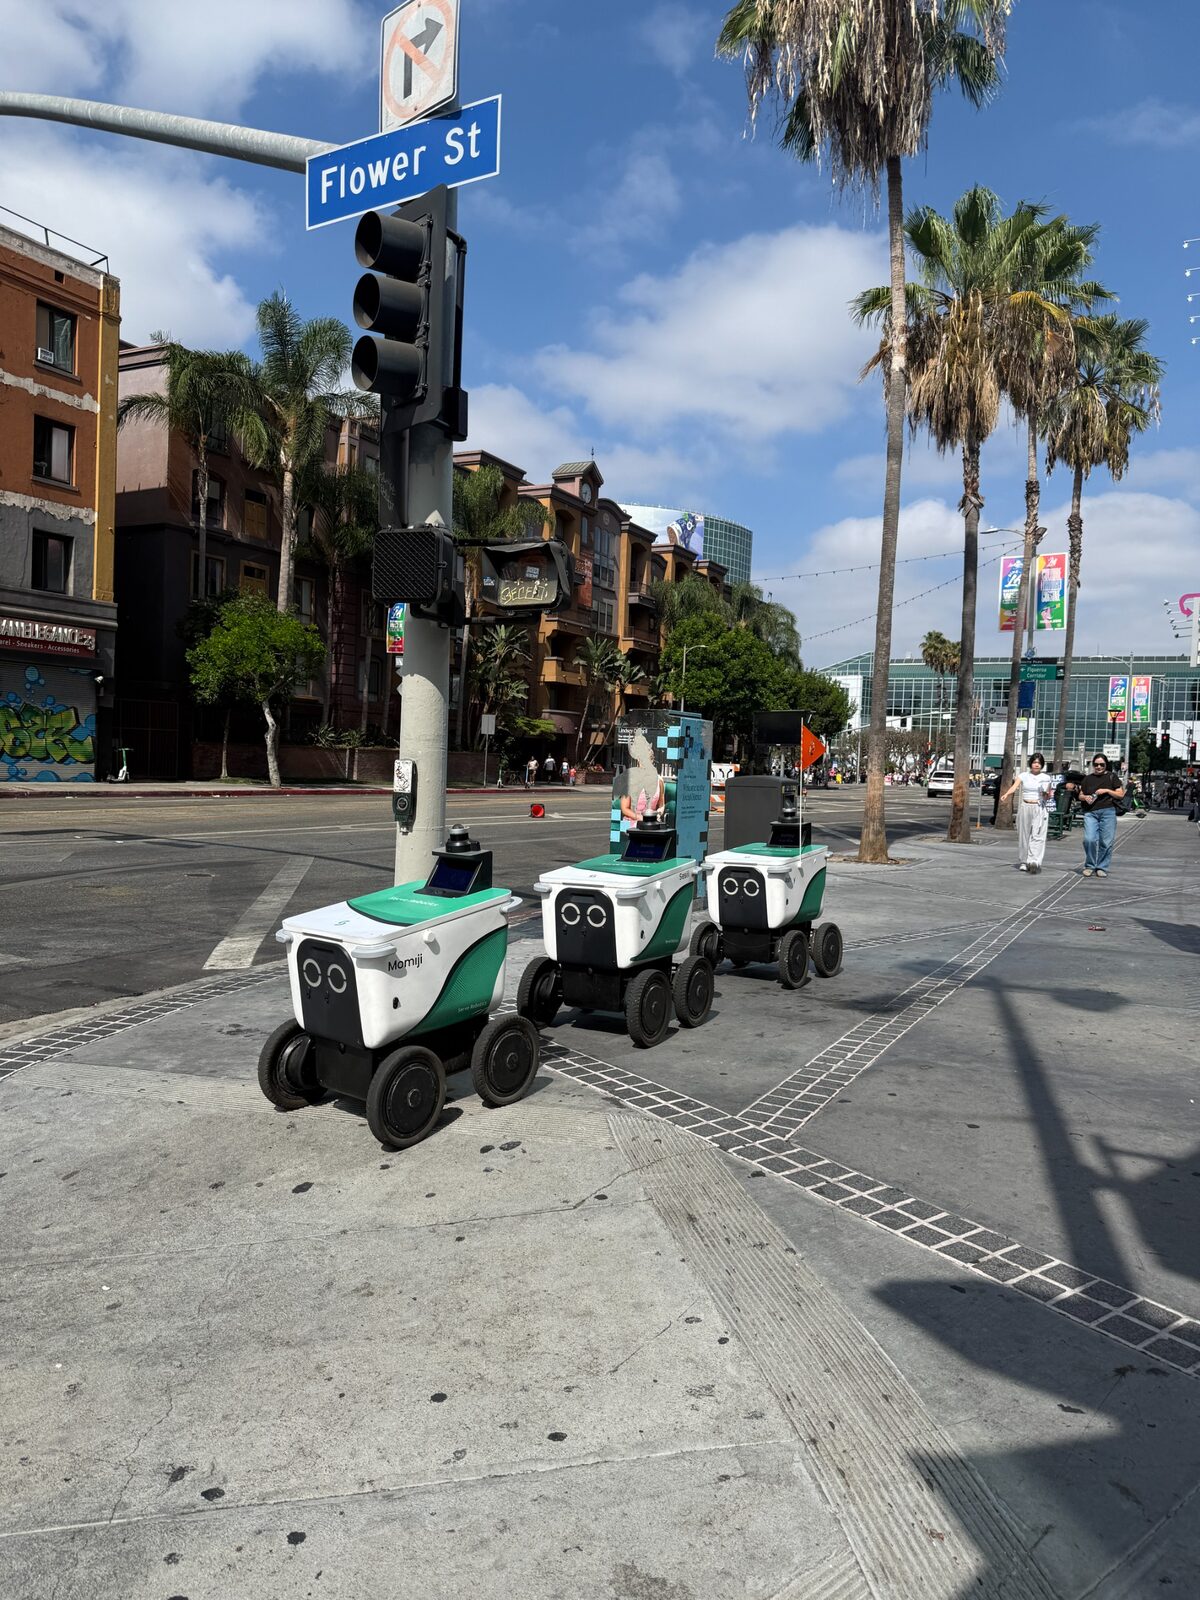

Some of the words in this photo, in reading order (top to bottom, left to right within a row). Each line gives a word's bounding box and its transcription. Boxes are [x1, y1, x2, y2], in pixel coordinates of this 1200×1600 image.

[321, 145, 427, 204] Flower
[444, 121, 481, 165] St
[16, 639, 44, 649] Sneakers
[48, 644, 80, 654] Accessories
[388, 953, 423, 972] Momiji
